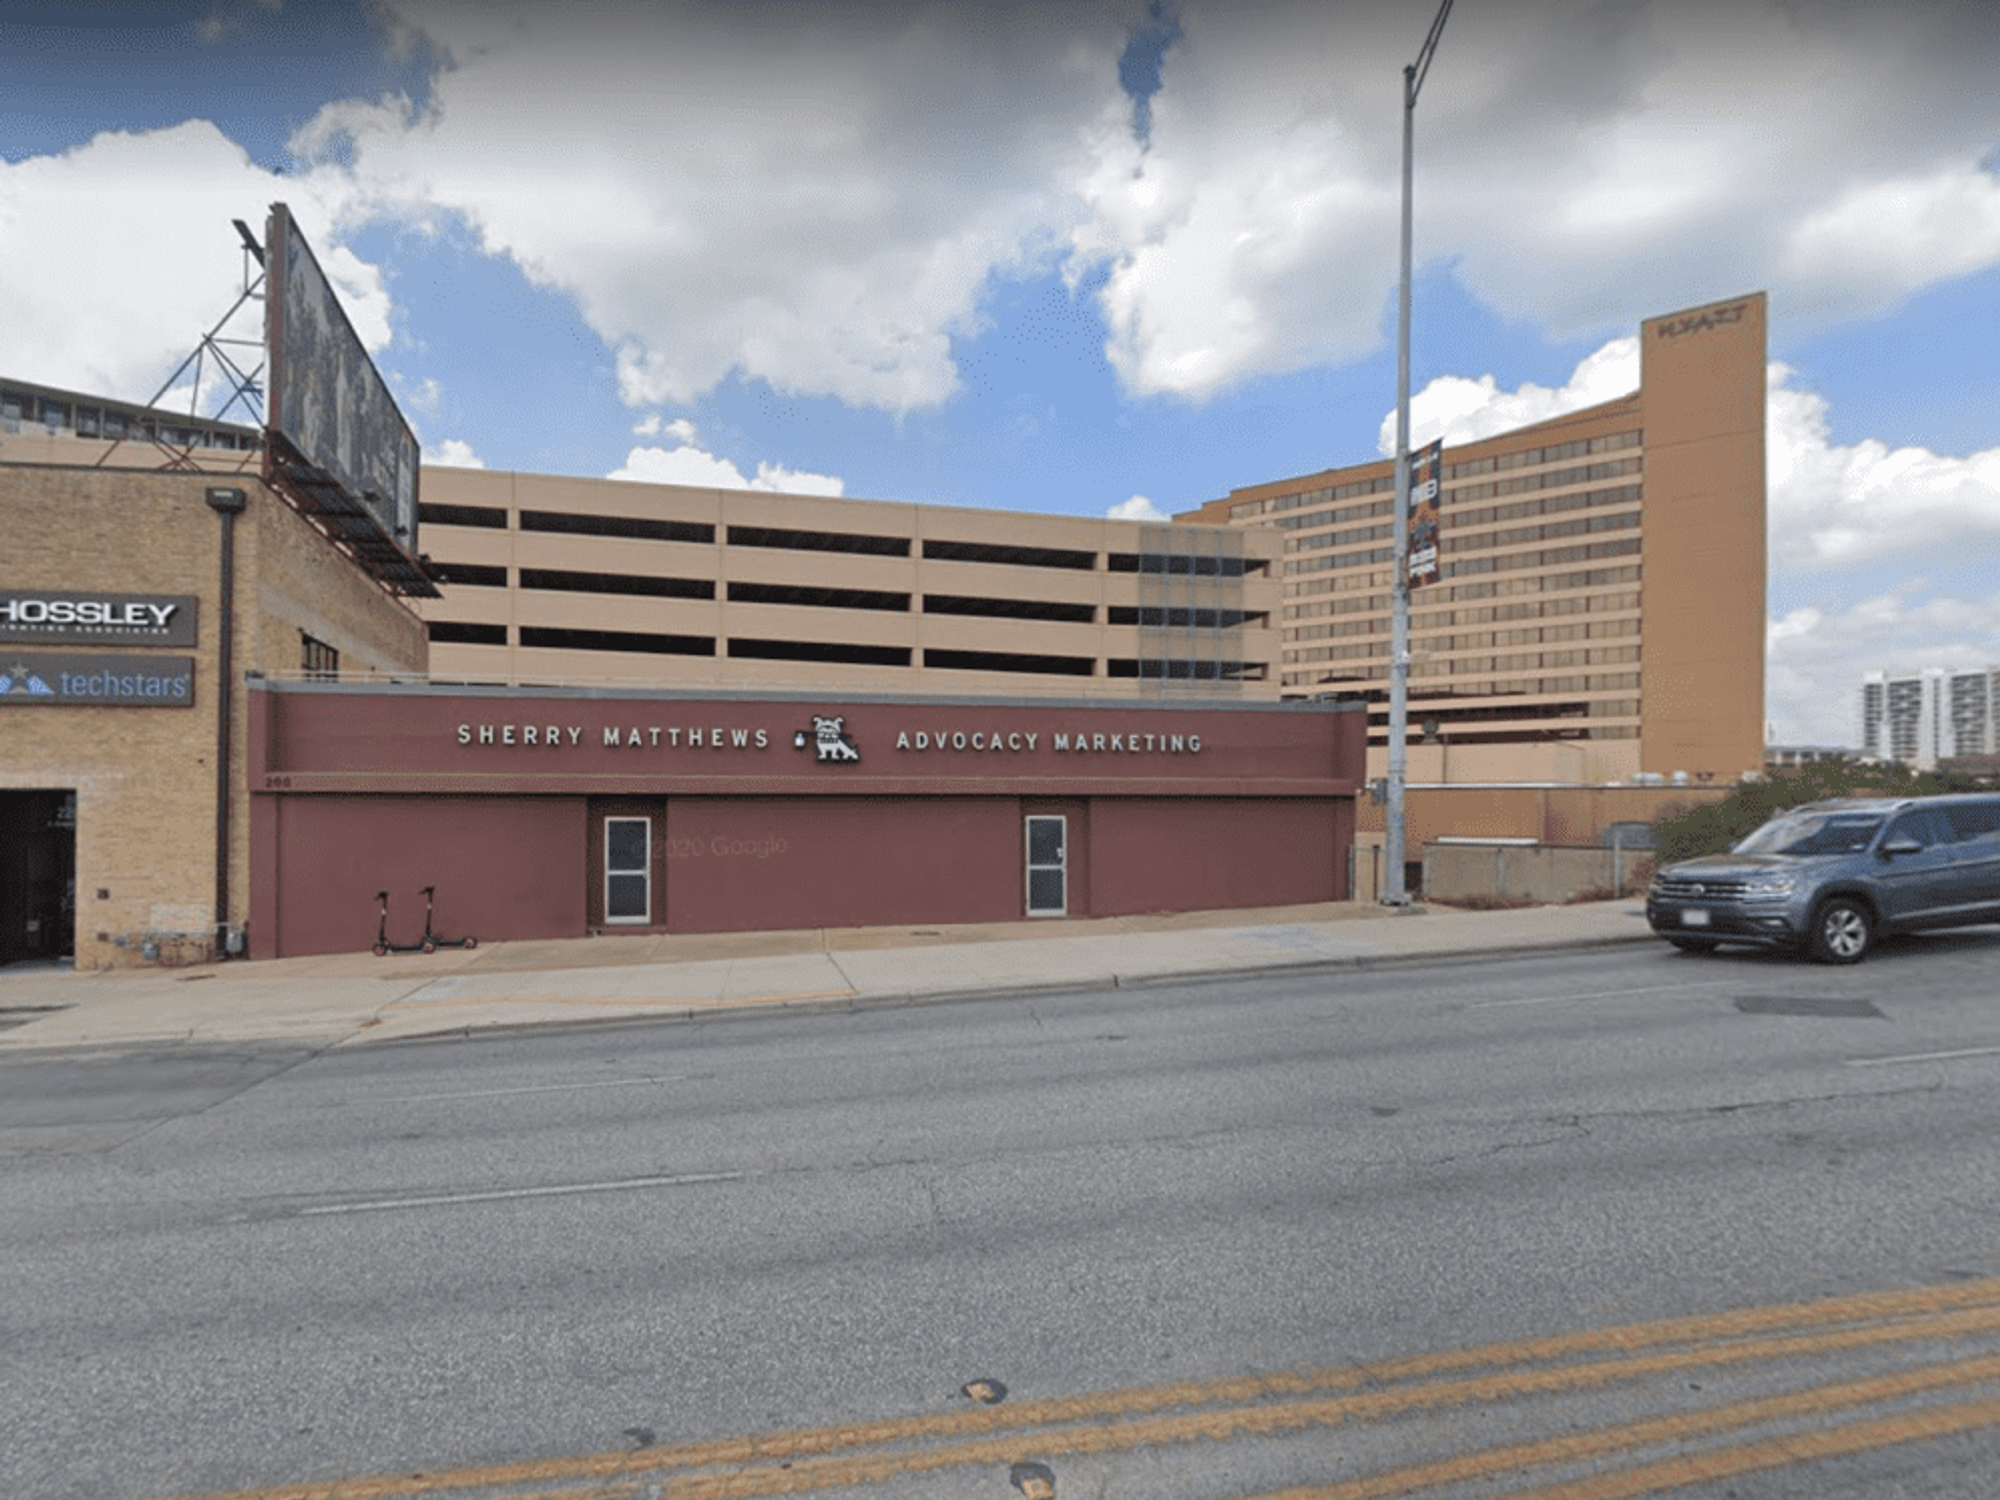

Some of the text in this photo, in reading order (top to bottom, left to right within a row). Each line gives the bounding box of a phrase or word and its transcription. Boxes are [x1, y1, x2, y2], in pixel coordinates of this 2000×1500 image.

[60, 670, 187, 698] techstars
[456, 724, 1201, 752] SHERRY MATTHEWS ADVOCACY MARKETING
